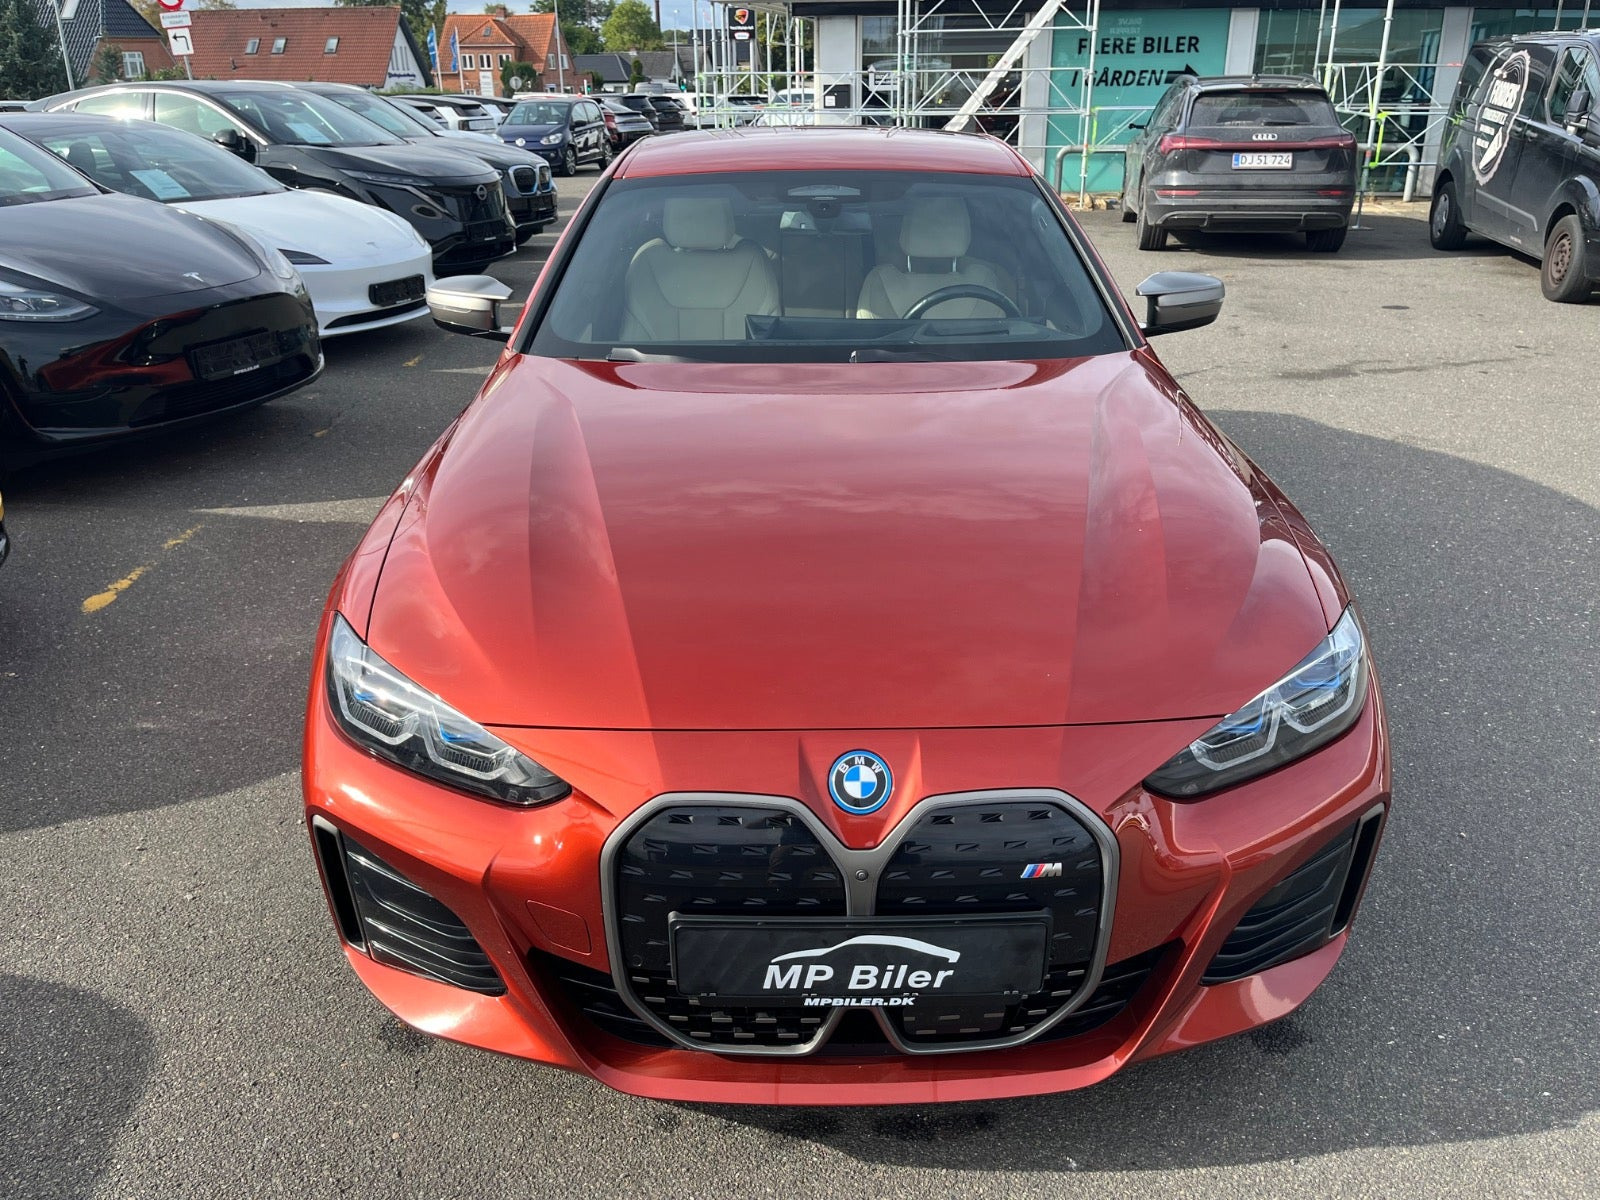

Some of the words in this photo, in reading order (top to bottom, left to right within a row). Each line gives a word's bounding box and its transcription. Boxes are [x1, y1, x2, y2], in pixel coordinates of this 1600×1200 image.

[1142, 36, 1200, 53] BILER
[1240, 155, 1254, 165] DJ
[1257, 155, 1268, 165] 51
[1271, 155, 1290, 165] 724
[838, 756, 883, 774] BMW
[762, 964, 834, 990] MP
[848, 964, 954, 989] Biler
[803, 996, 915, 1007] MPBILER.DK
